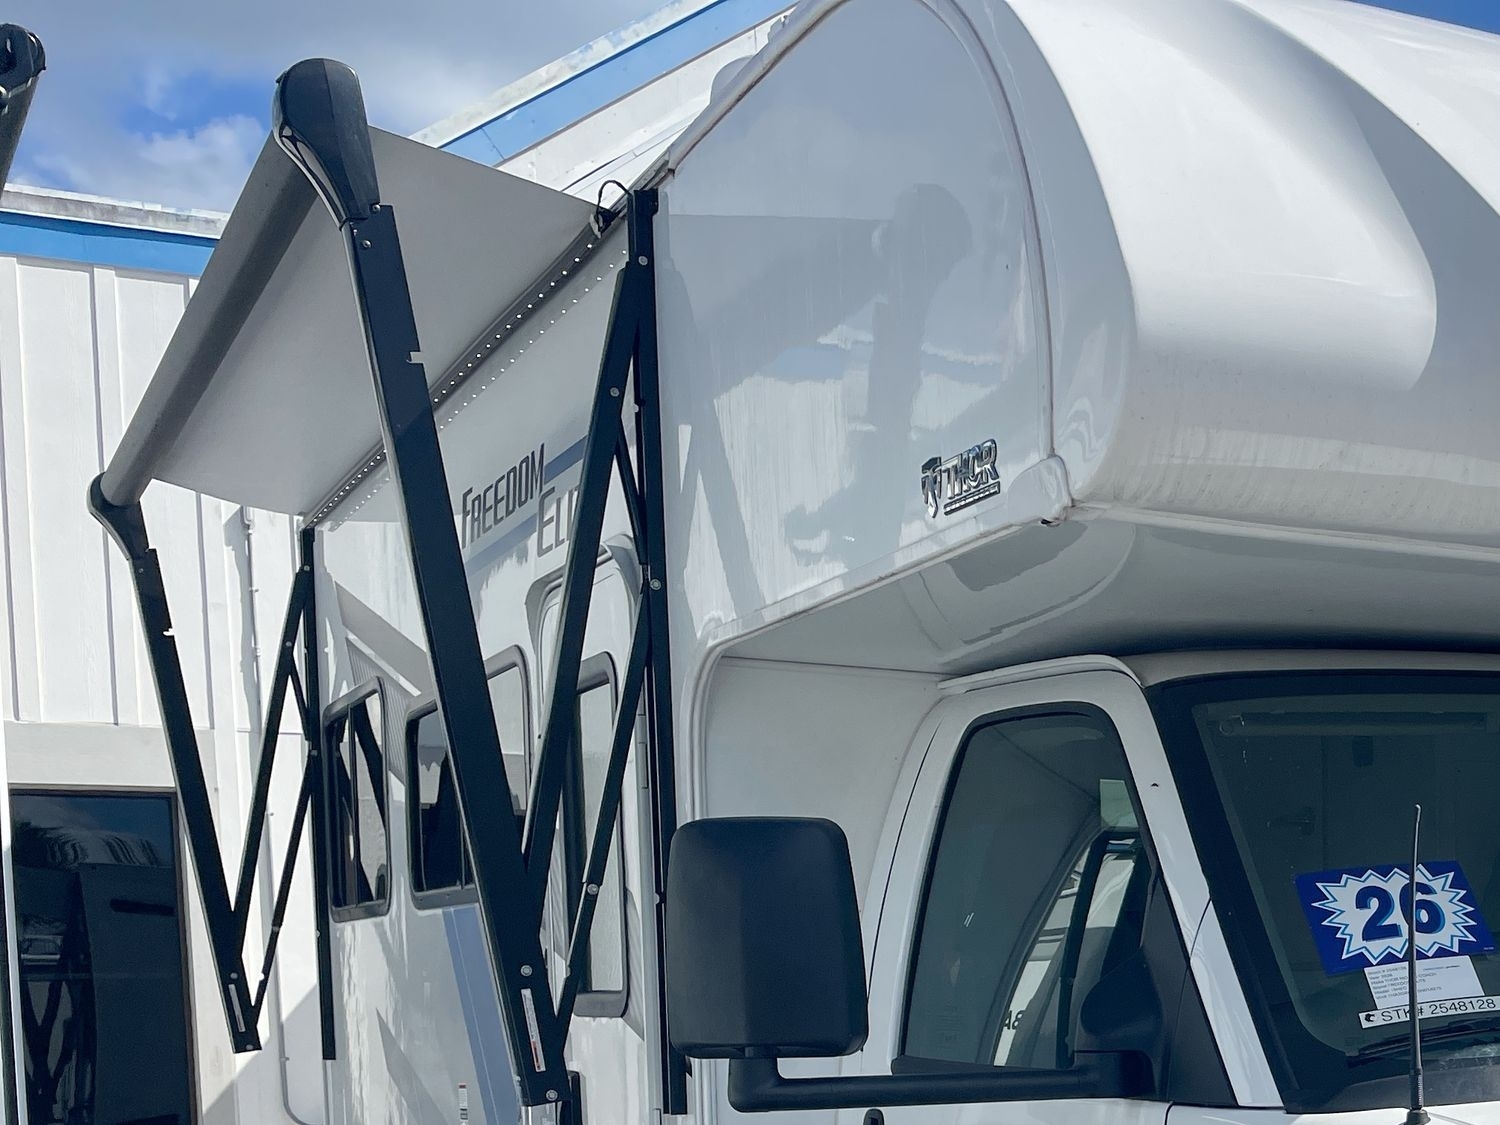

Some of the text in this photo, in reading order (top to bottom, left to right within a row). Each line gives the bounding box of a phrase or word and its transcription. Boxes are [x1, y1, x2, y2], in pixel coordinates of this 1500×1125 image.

[461, 443, 545, 550] FREEDOM
[537, 484, 581, 557] ELI
[1355, 881, 1446, 942] 26
[1428, 998, 1497, 1015] 2548128
